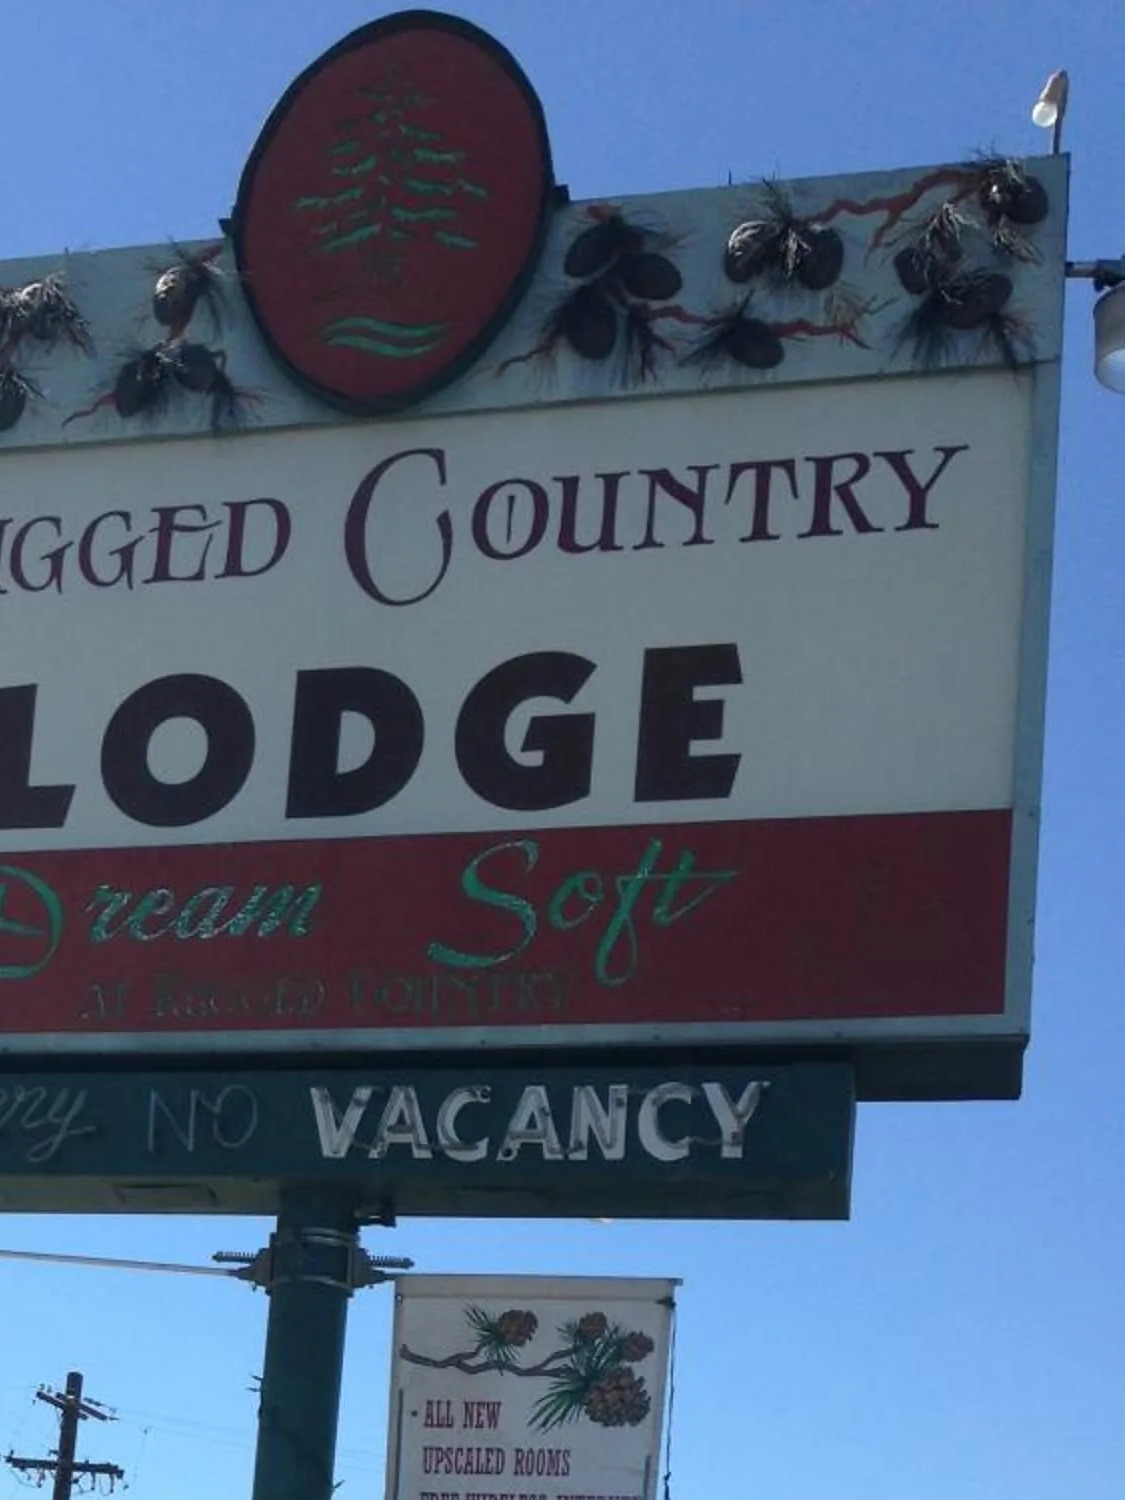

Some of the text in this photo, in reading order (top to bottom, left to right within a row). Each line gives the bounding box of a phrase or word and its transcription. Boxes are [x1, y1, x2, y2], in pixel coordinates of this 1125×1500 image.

[343, 444, 970, 607] COUNTRY
[426, 837, 740, 988] Soft
[146, 1082, 259, 1154] NO
[309, 1080, 772, 1162] VACANCY
[423, 1400, 502, 1429] ALL NEW
[422, 1446, 572, 1477] UPSCALED ROOMS
